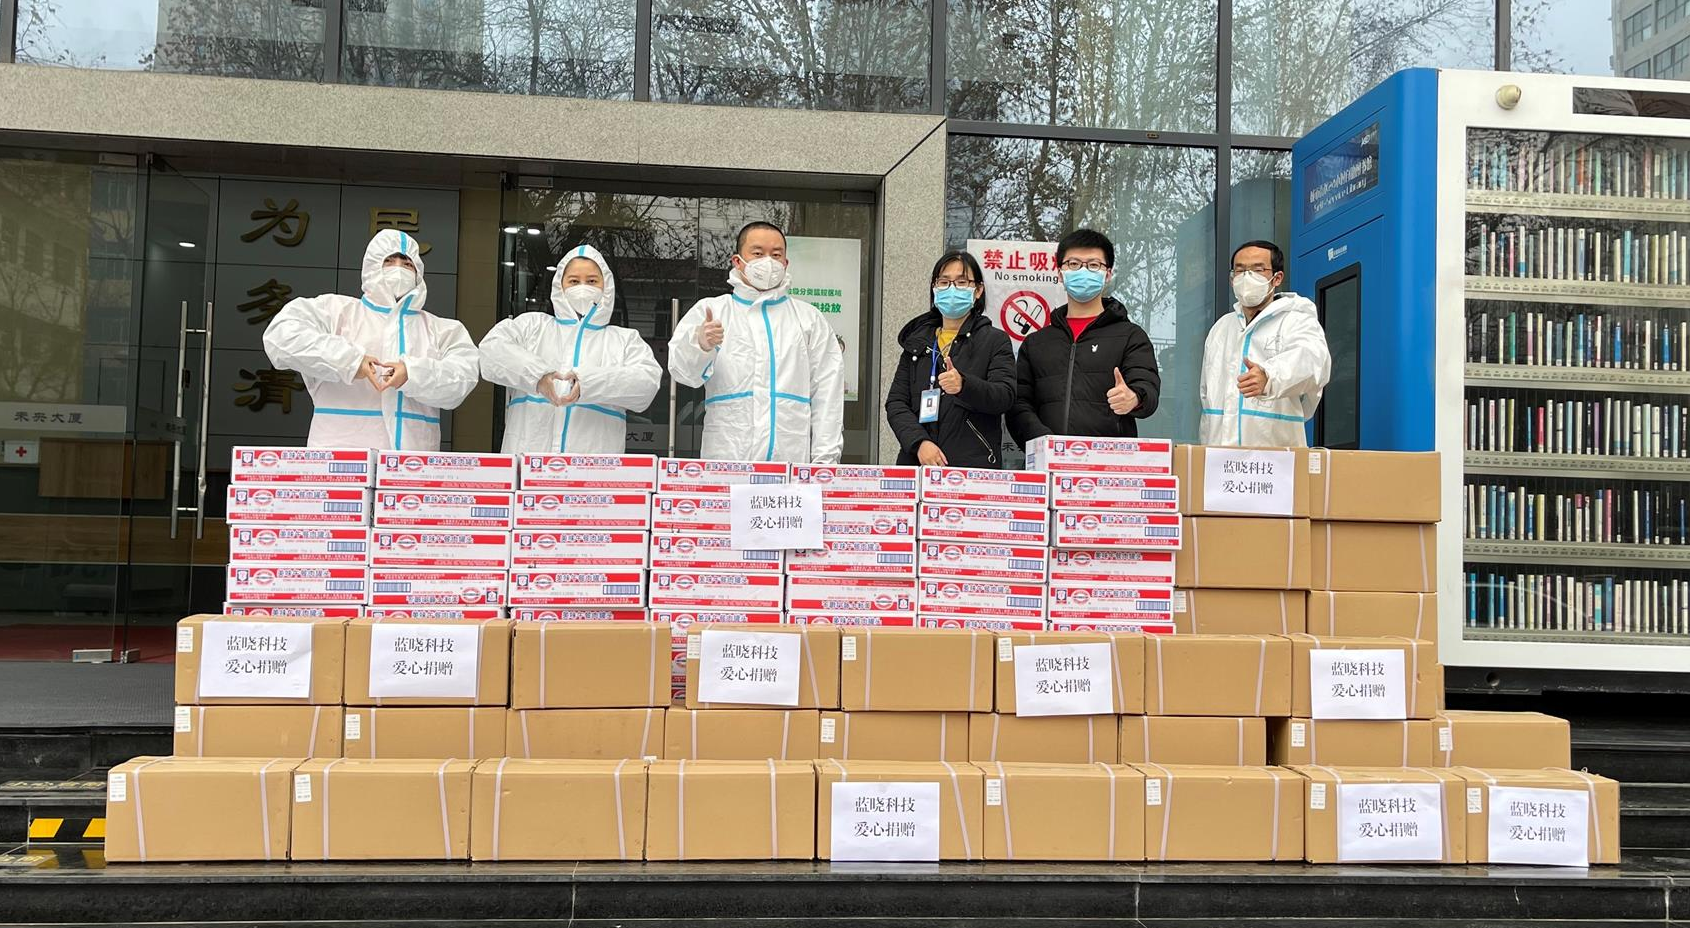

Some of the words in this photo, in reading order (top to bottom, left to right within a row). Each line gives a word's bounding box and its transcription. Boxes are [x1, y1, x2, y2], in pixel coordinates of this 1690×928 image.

[241, 198, 309, 247] 为
[994, 271, 1010, 281] No
[1012, 272, 1059, 284] smoking
[1223, 460, 1273, 475] 蓝晓科技
[1222, 480, 1273, 494] 爱心捐赠
[750, 495, 802, 509] 蓝晓科技
[750, 516, 803, 530] 爱心捐赠
[227, 636, 287, 651] 蓝晓科技
[394, 637, 454, 653] 蓝晓科技
[722, 644, 778, 660] 蓝晓科技
[225, 659, 287, 674] 爱心捐赠
[393, 660, 453, 676] 爱心捐赠
[1035, 656, 1090, 672] 蓝晓科技
[1331, 662, 1385, 676] 蓝晓科技
[720, 666, 777, 682] 爱心捐赠
[1036, 678, 1091, 694] 爱心捐赠
[1331, 683, 1386, 698] 爱心捐赠
[855, 796, 915, 813] 蓝晓科技
[1358, 798, 1416, 814] 蓝晓科技
[1510, 801, 1567, 818] 蓝晓科技
[854, 821, 915, 837] 爱心捐赠
[1359, 822, 1418, 838] 爱心捐赠
[1508, 825, 1567, 843] 爱心捐赠
